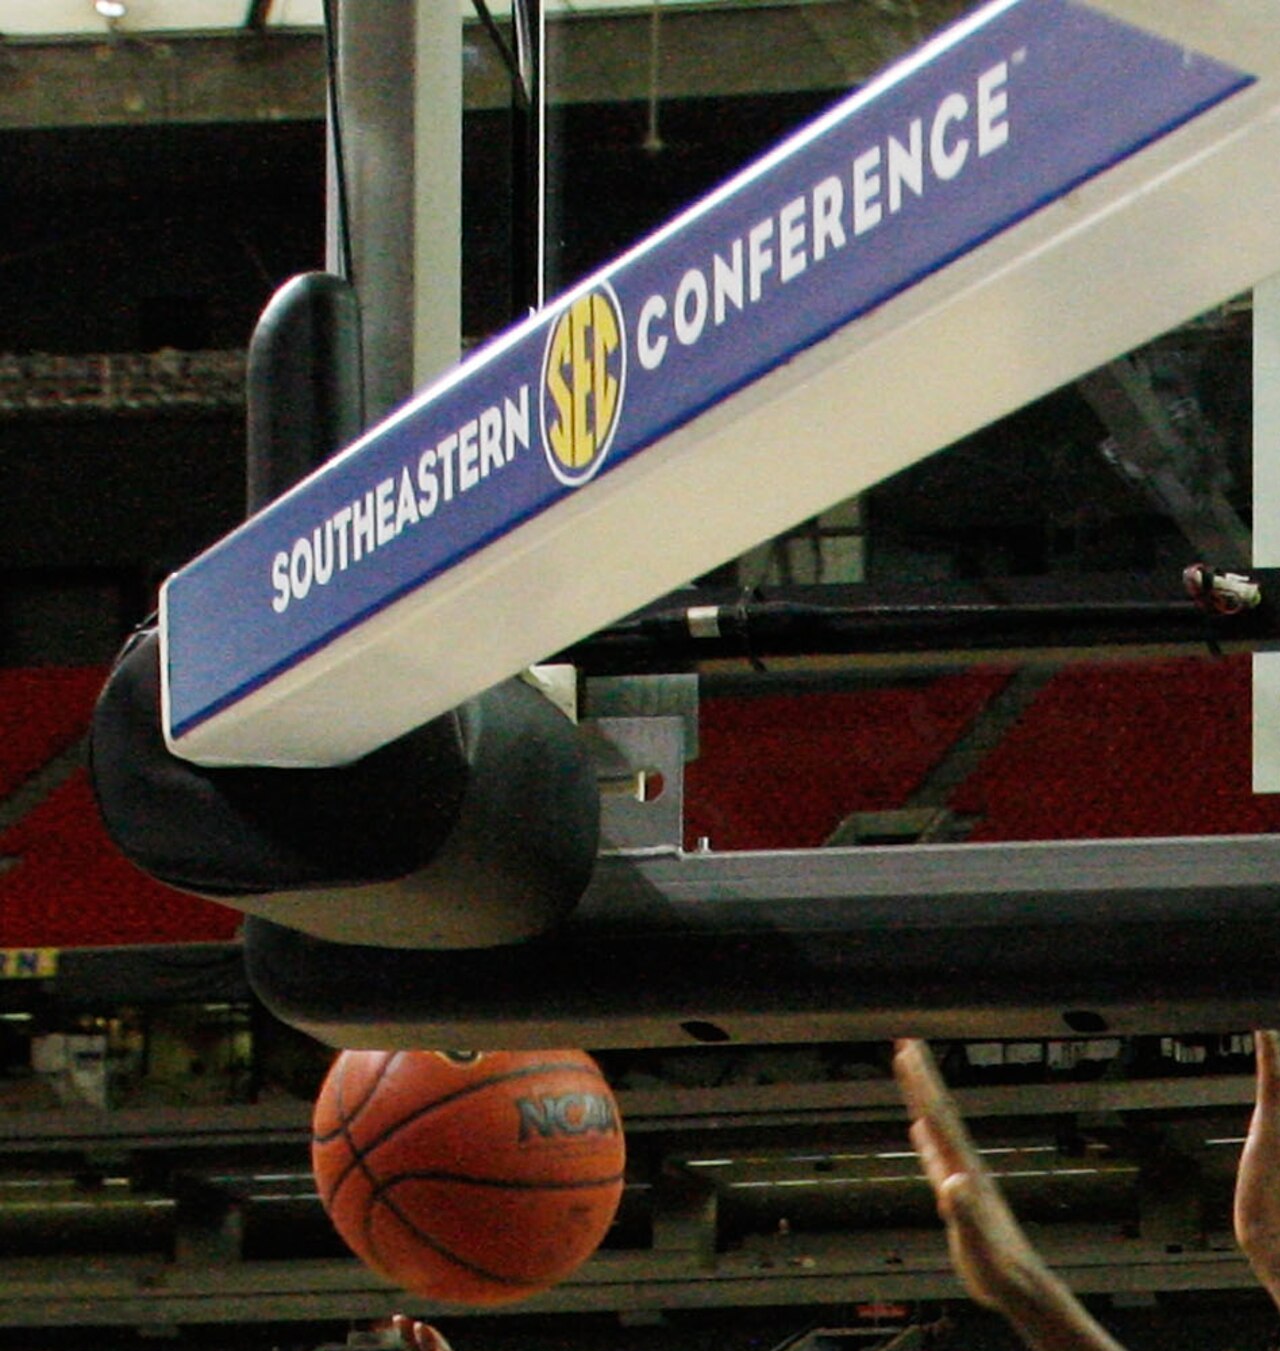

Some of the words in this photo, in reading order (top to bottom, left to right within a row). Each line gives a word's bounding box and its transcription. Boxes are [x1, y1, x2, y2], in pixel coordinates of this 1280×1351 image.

[272, 386, 530, 613] SOUTHEASTERN
[543, 294, 623, 468] SEC
[637, 62, 1010, 369] CONFERENCE
